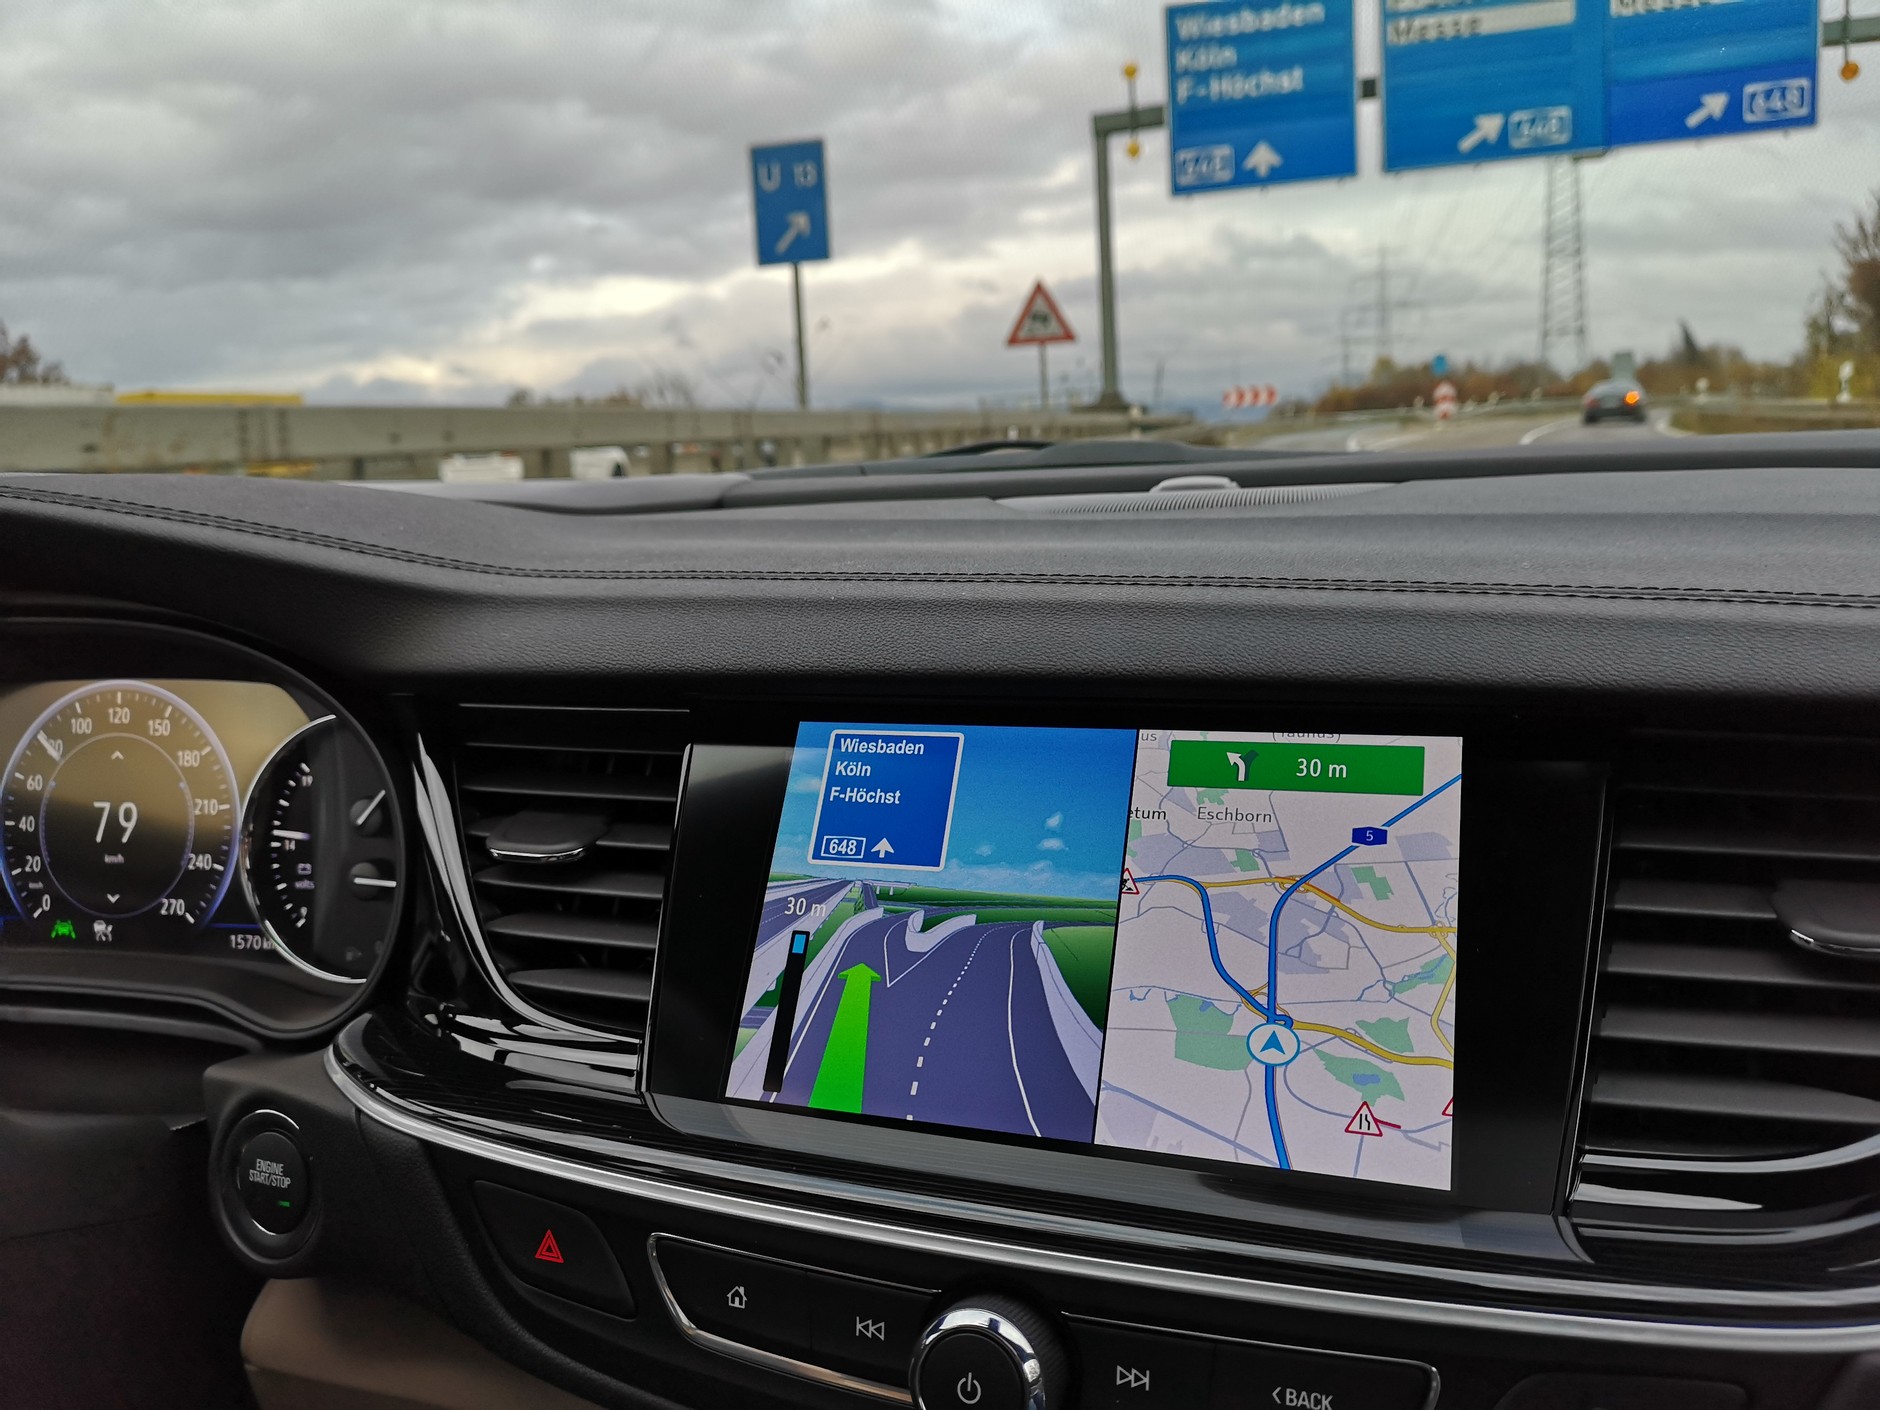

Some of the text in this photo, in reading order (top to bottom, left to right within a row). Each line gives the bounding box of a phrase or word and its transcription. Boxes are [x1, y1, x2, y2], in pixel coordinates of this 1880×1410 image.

[758, 160, 781, 192] U
[108, 707, 131, 724] 120
[71, 718, 92, 734] 100
[148, 719, 171, 737] 150
[841, 738, 925, 755] Wiesbaden
[177, 750, 200, 767] 180
[835, 761, 871, 776] Köln
[1296, 758, 1347, 778] 30 m
[27, 774, 43, 791] 60
[829, 787, 901, 804] F-Höchst
[195, 798, 218, 816] 210
[1197, 806, 1272, 823] Eschborn
[19, 815, 35, 832] 40
[93, 801, 138, 843] 79
[1366, 830, 1374, 842] 5
[829, 839, 857, 854] 648
[25, 855, 41, 872] 20
[188, 852, 212, 870] 240
[42, 894, 51, 911] 0
[160, 898, 185, 916] 270
[785, 896, 827, 917] 30 m
[230, 934, 261, 950] 1570
[256, 1158, 284, 1176] ENGINE
[249, 1169, 291, 1189] START/STOP
[1285, 1388, 1334, 1410] BACK
